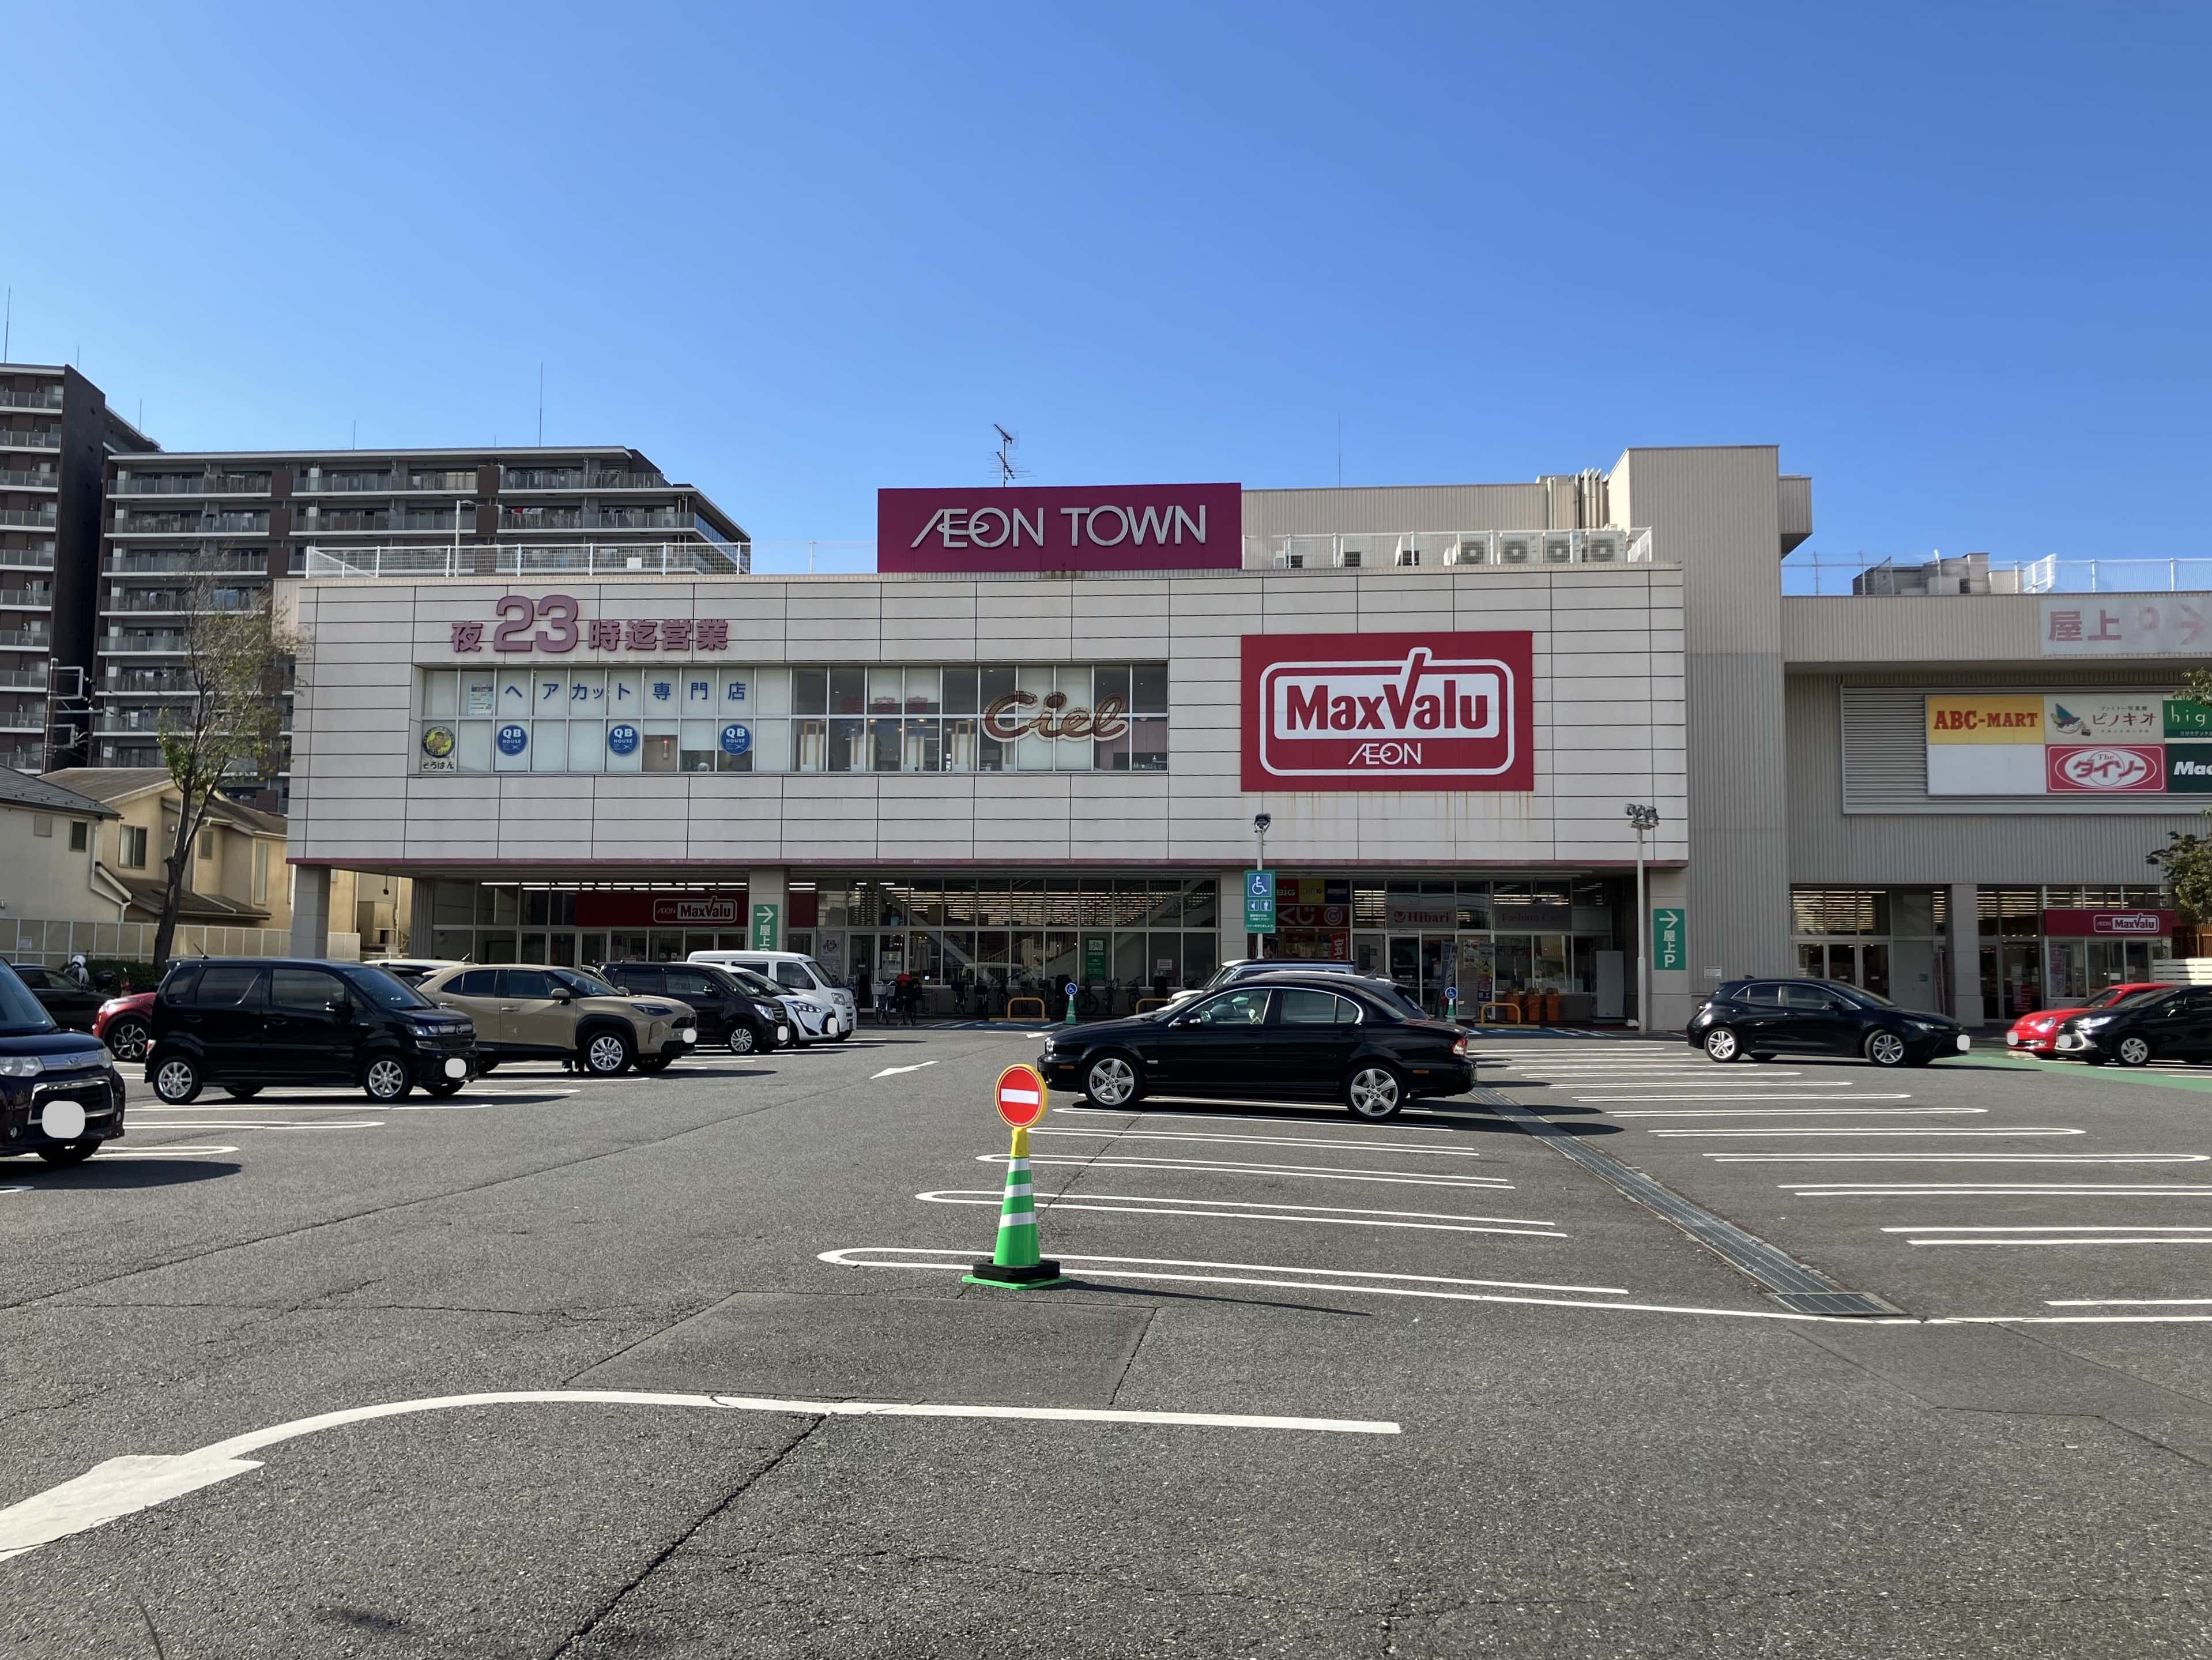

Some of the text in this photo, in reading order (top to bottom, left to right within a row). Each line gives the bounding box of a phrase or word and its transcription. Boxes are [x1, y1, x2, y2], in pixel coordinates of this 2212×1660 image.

[1061, 505, 1206, 546] TOWN
[504, 681, 747, 701] ヘアカット専門店
[1286, 653, 1488, 731] MaxValu
[981, 691, 1129, 742] Ciel
[1934, 710, 2038, 730] ABC-MART
[2093, 712, 2157, 727] ピノキオ
[2171, 705, 2206, 727] hig
[503, 729, 521, 739] QB
[614, 728, 633, 738] QB
[726, 728, 745, 738] QB
[2074, 759, 2145, 778] ダイソー
[681, 897, 731, 917] MaxValu
[2115, 913, 2154, 928] MaxValu
[759, 925, 771, 951] 屋上
[1663, 930, 1676, 968] 屋上P
